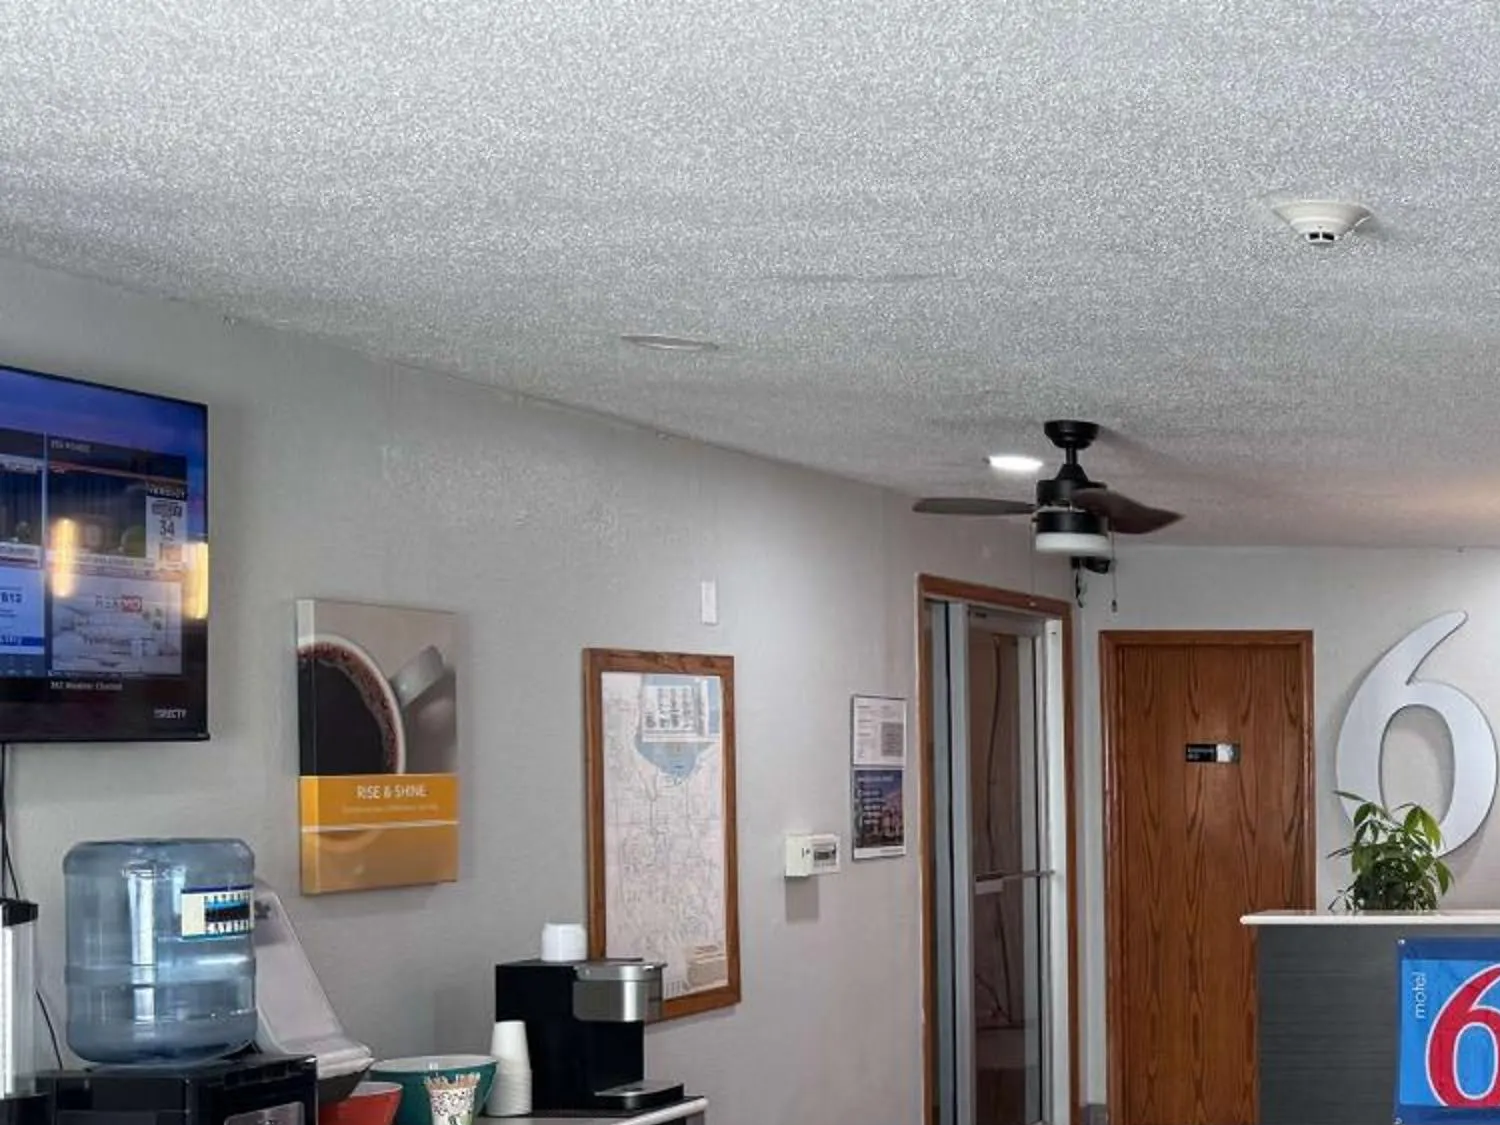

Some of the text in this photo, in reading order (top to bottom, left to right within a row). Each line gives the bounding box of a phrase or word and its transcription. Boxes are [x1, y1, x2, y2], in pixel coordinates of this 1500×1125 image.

[1336, 610, 1499, 858] 6
[356, 784, 381, 799] RISE
[395, 782, 428, 798] SHINE
[1412, 971, 1426, 1019] motel
